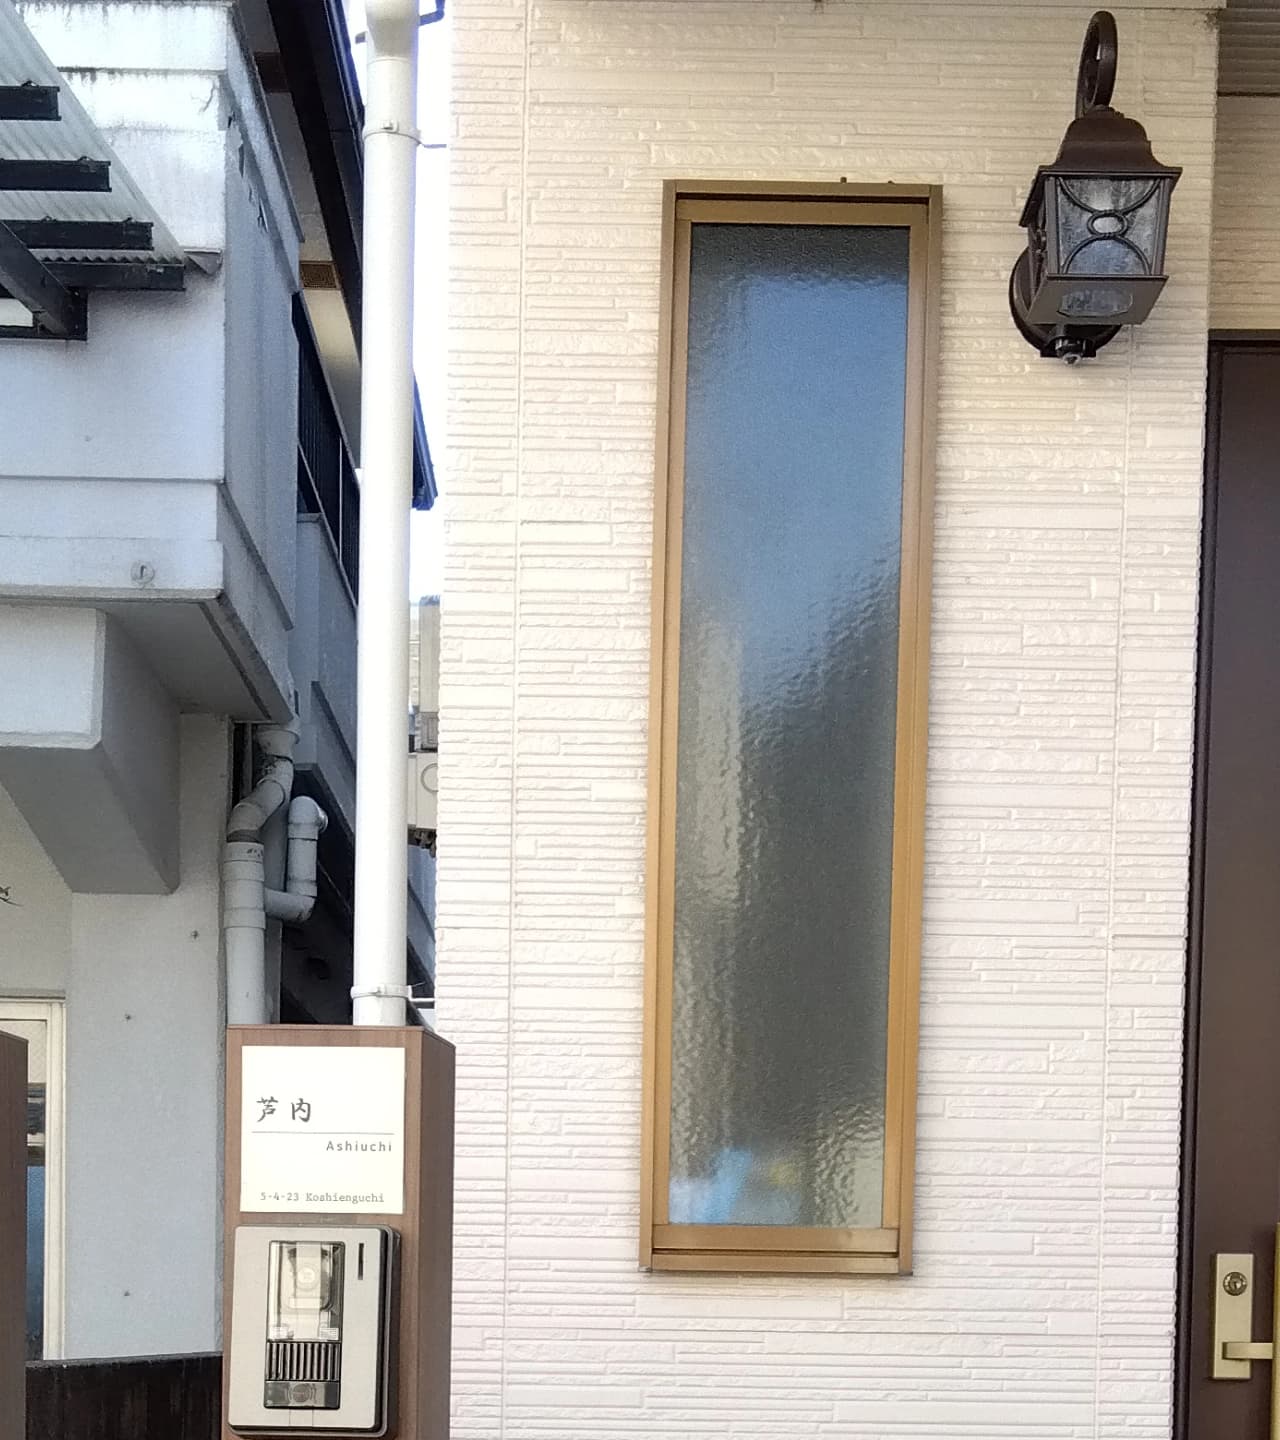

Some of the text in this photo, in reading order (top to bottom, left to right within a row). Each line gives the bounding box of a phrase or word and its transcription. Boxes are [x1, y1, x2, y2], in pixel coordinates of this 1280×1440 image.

[326, 1140, 393, 1152] Ashiuchi
[260, 1191, 386, 1204] 5-4-23 Koshienguchi
